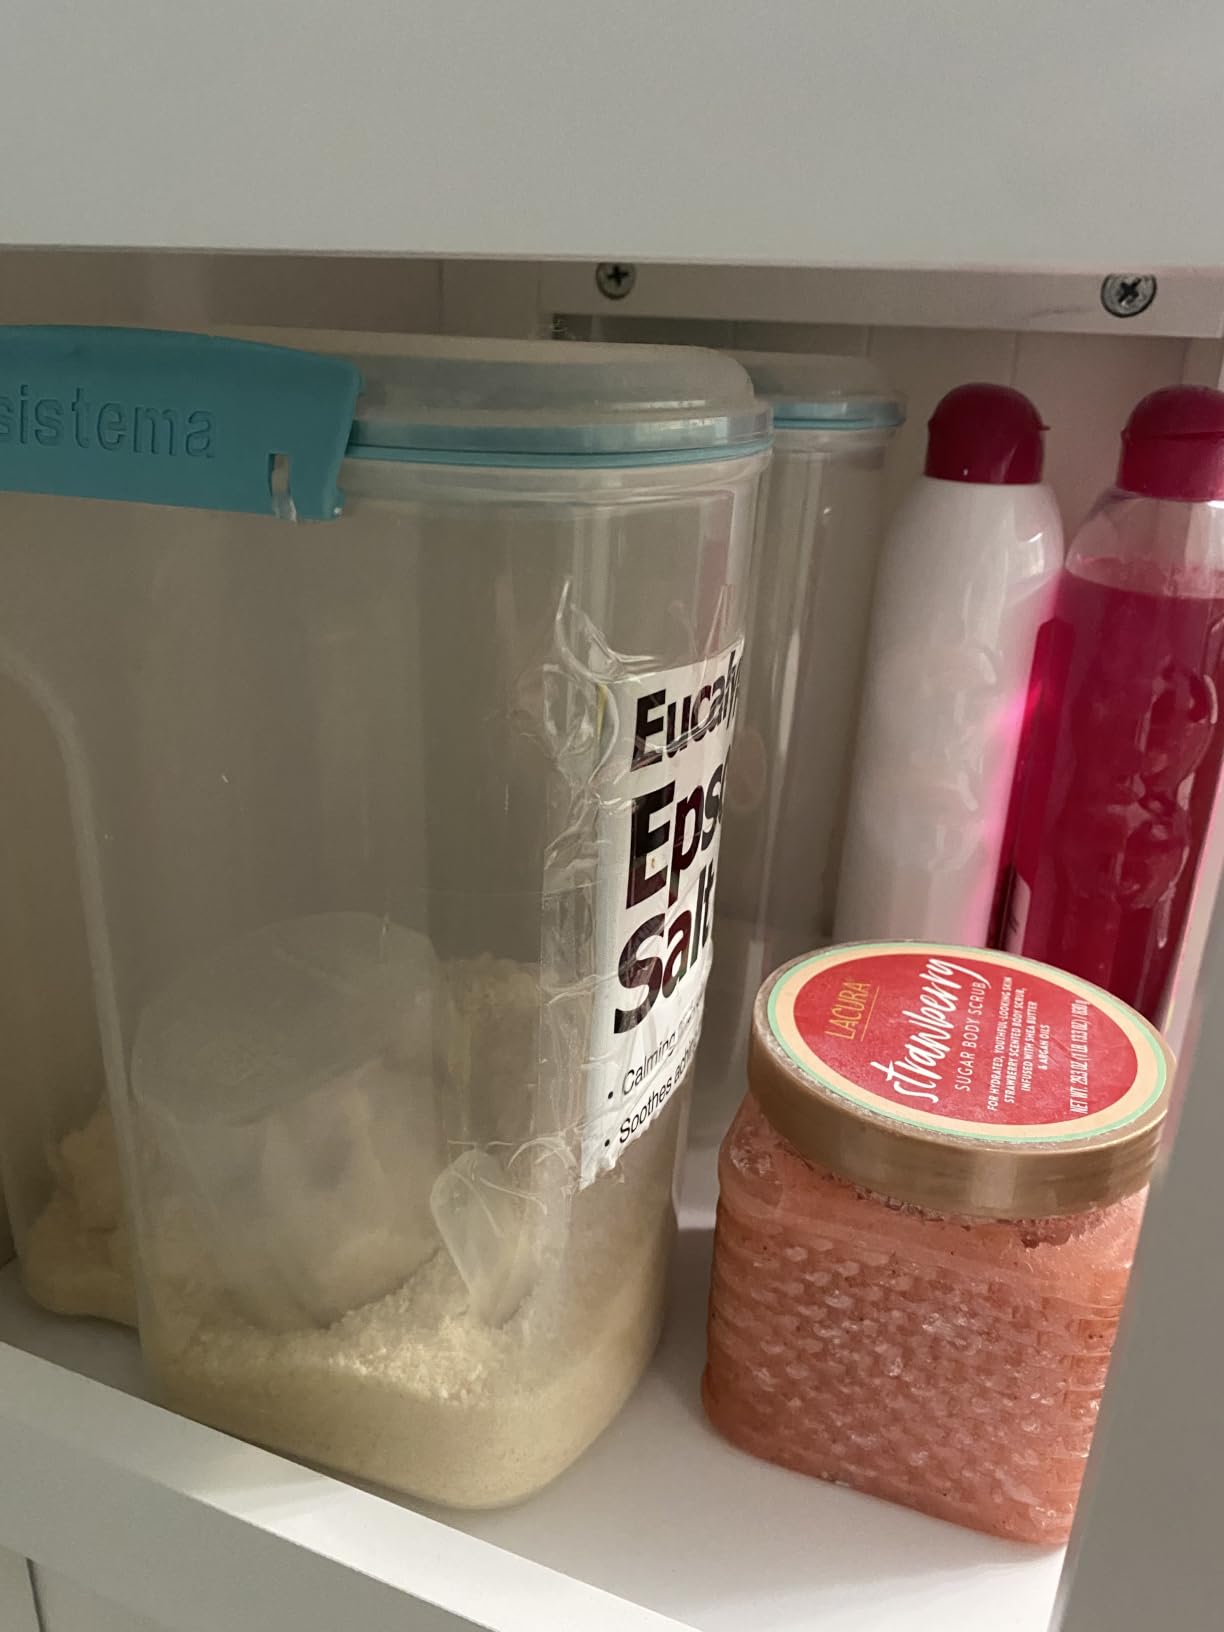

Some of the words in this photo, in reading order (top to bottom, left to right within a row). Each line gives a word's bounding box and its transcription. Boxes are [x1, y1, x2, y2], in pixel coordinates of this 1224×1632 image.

[625, 744, 731, 910] Eps
[613, 858, 714, 1034] Salt
[824, 982, 871, 1040] LACURA
[967, 981, 987, 1016] SCRUB
[1026, 1001, 1038, 1025] BUTTER
[870, 958, 992, 1104] strawberry
[961, 1017, 981, 1049] BODY
[993, 991, 1012, 1054] YOUTHFUL-LOOKING
[1011, 1009, 1023, 1027] BODY
[1024, 1025, 1036, 1043] SHEA
[1039, 1024, 1050, 1040] OILS
[1008, 1027, 1022, 1057] SCENTED
[1023, 1041, 1035, 1060] WITH
[1038, 1039, 1049, 1065] ARGAN
[621, 1031, 677, 1096] Calming
[954, 1051, 976, 1092] SUGAR
[989, 1055, 1006, 1095] HYDRATED,
[1020, 1060, 1033, 1092] INFUSED
[1003, 1056, 1019, 1104] STRAWBERRY
[1070, 1086, 1089, 1099] WT.
[619, 1076, 673, 1143] Soothes
[987, 1095, 999, 1111] FOR
[1070, 1098, 1089, 1114] NET
